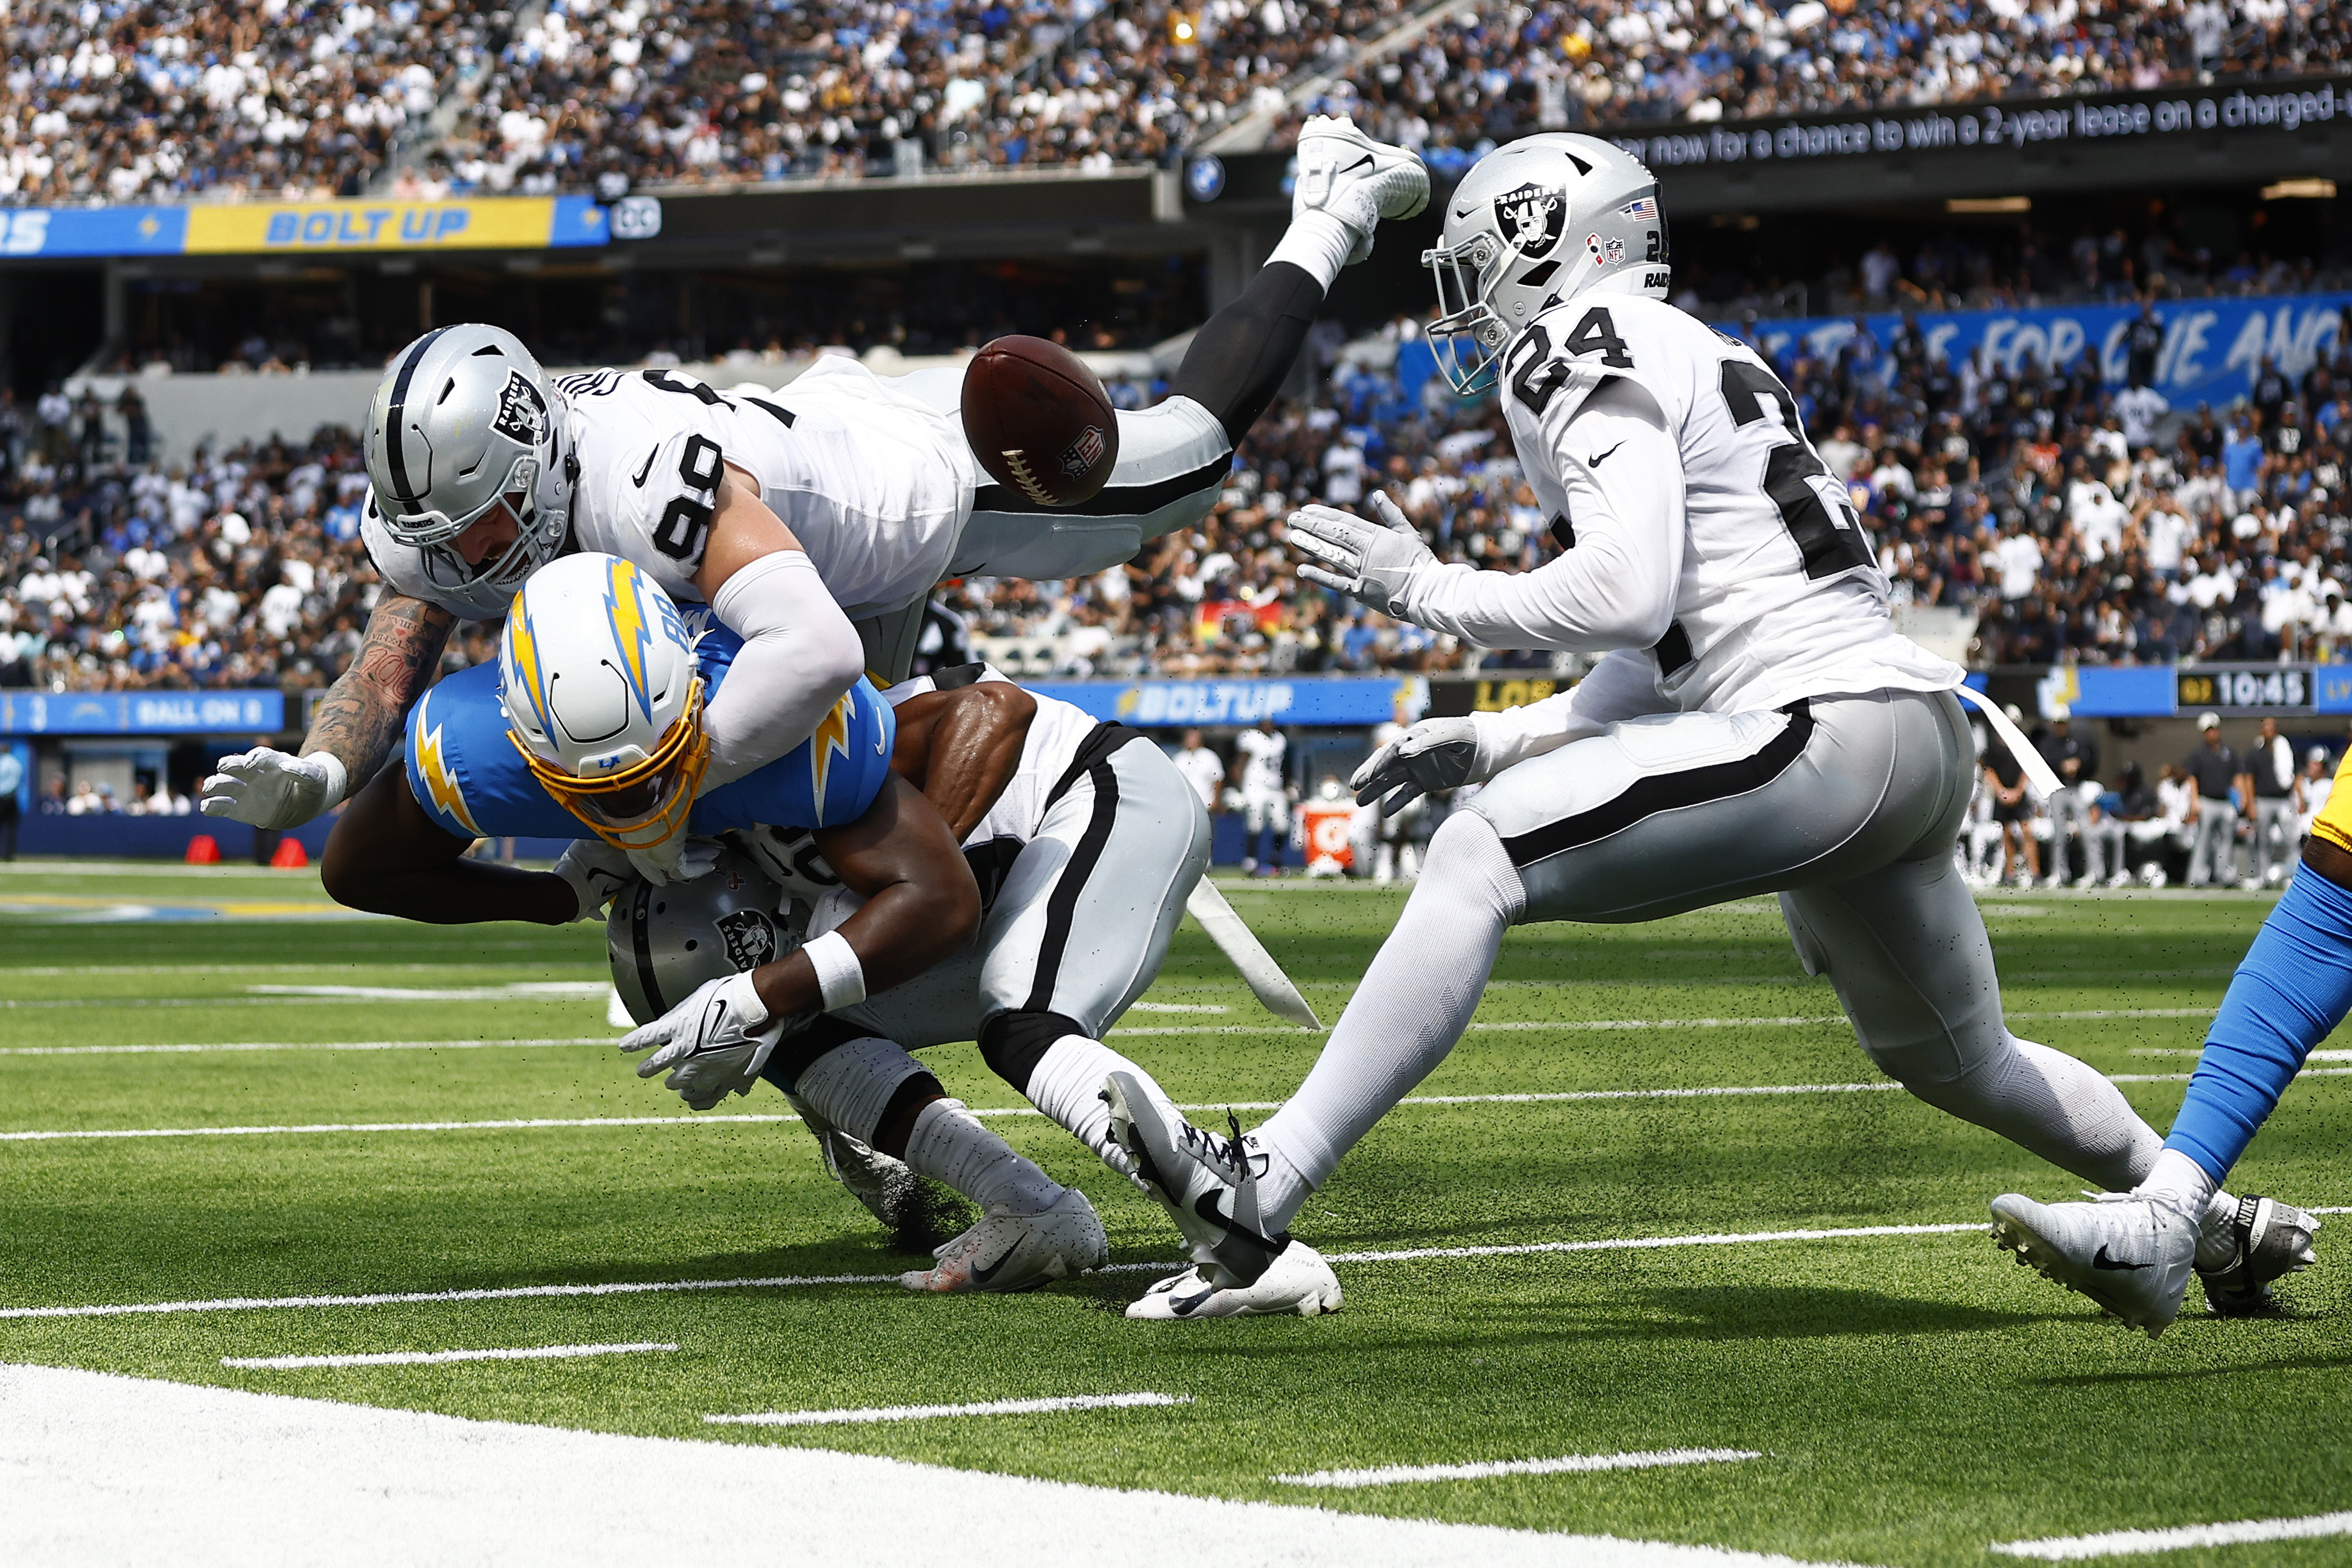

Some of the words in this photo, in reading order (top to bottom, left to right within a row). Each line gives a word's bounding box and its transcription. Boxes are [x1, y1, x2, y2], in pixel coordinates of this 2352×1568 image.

[1648, 133, 1710, 165] now
[1709, 126, 1748, 163] for
[1750, 129, 1773, 159] a
[1772, 120, 1871, 158] chance
[1872, 117, 1904, 151] to
[1904, 110, 1956, 150] win
[1957, 115, 1979, 145] a
[1982, 106, 2073, 150] 2-year
[2074, 99, 2150, 138] lease
[2153, 100, 2192, 132] on
[2196, 98, 2217, 129] a
[266, 209, 393, 244] BOLT
[400, 207, 471, 241] UP
[1608, 249, 1623, 261] NFL
[1505, 306, 1635, 418] 24
[498, 376, 520, 427] RAIDERS
[653, 433, 723, 568] 98
[2218, 671, 2305, 706] 10:45
[723, 925, 748, 968] AIDERS
[2237, 1197, 2257, 1227] NIKE
